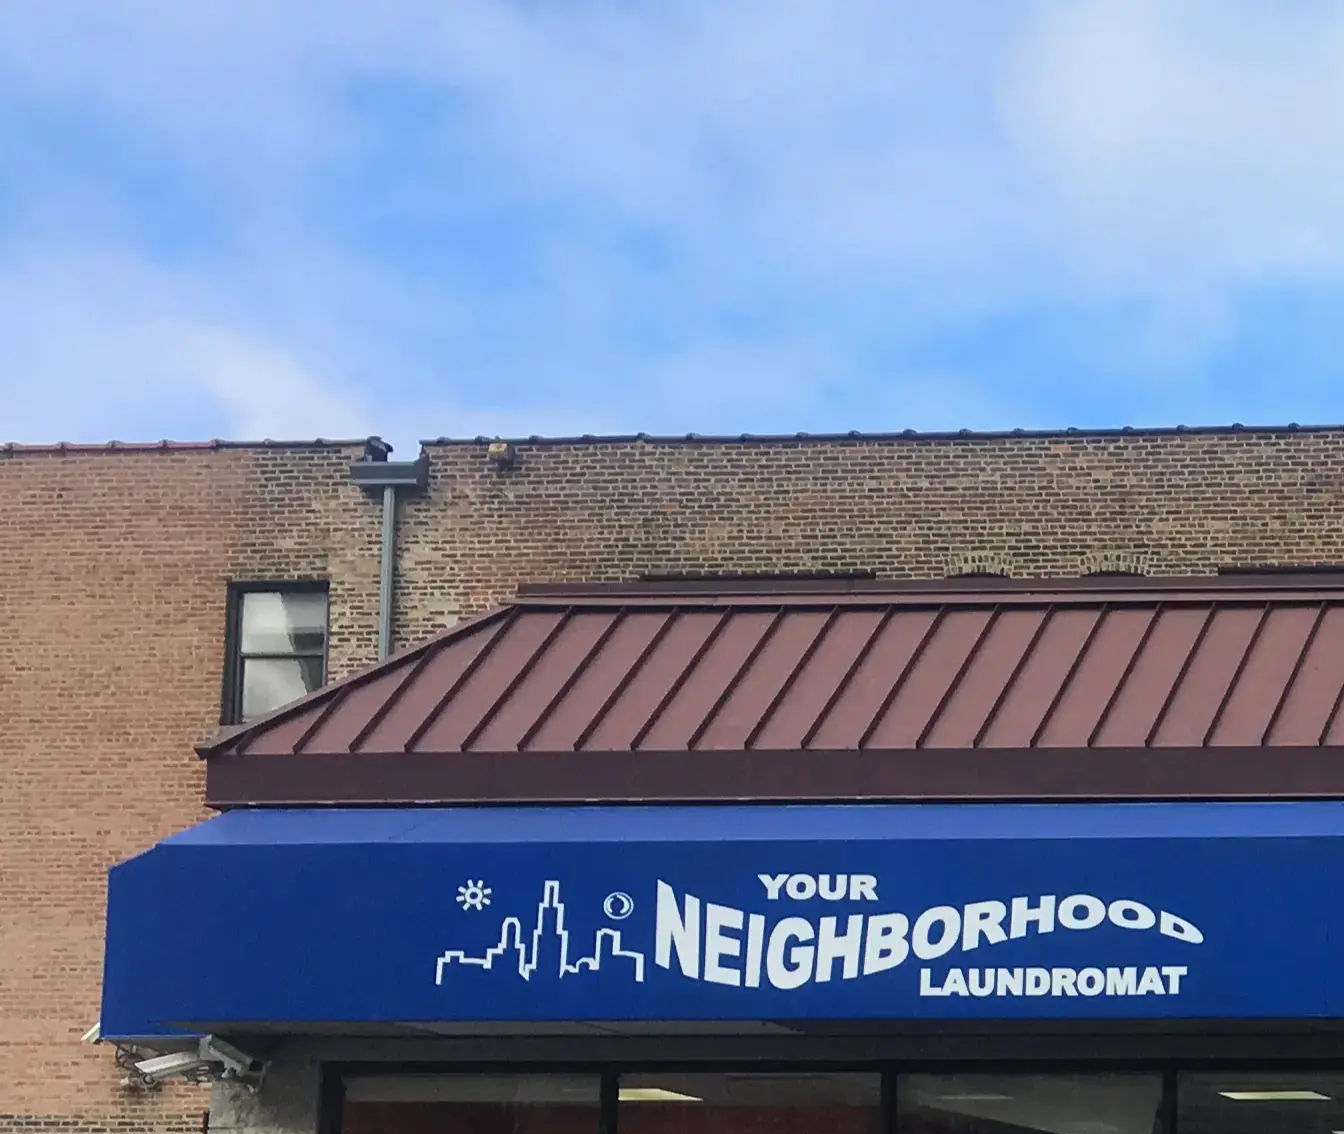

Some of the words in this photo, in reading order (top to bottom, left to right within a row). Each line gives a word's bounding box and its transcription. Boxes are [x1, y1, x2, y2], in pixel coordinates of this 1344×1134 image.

[758, 874, 878, 900] YOUR
[655, 879, 1204, 990] NEIGHBORHOOD
[920, 966, 1188, 997] LAUNDROMAT
